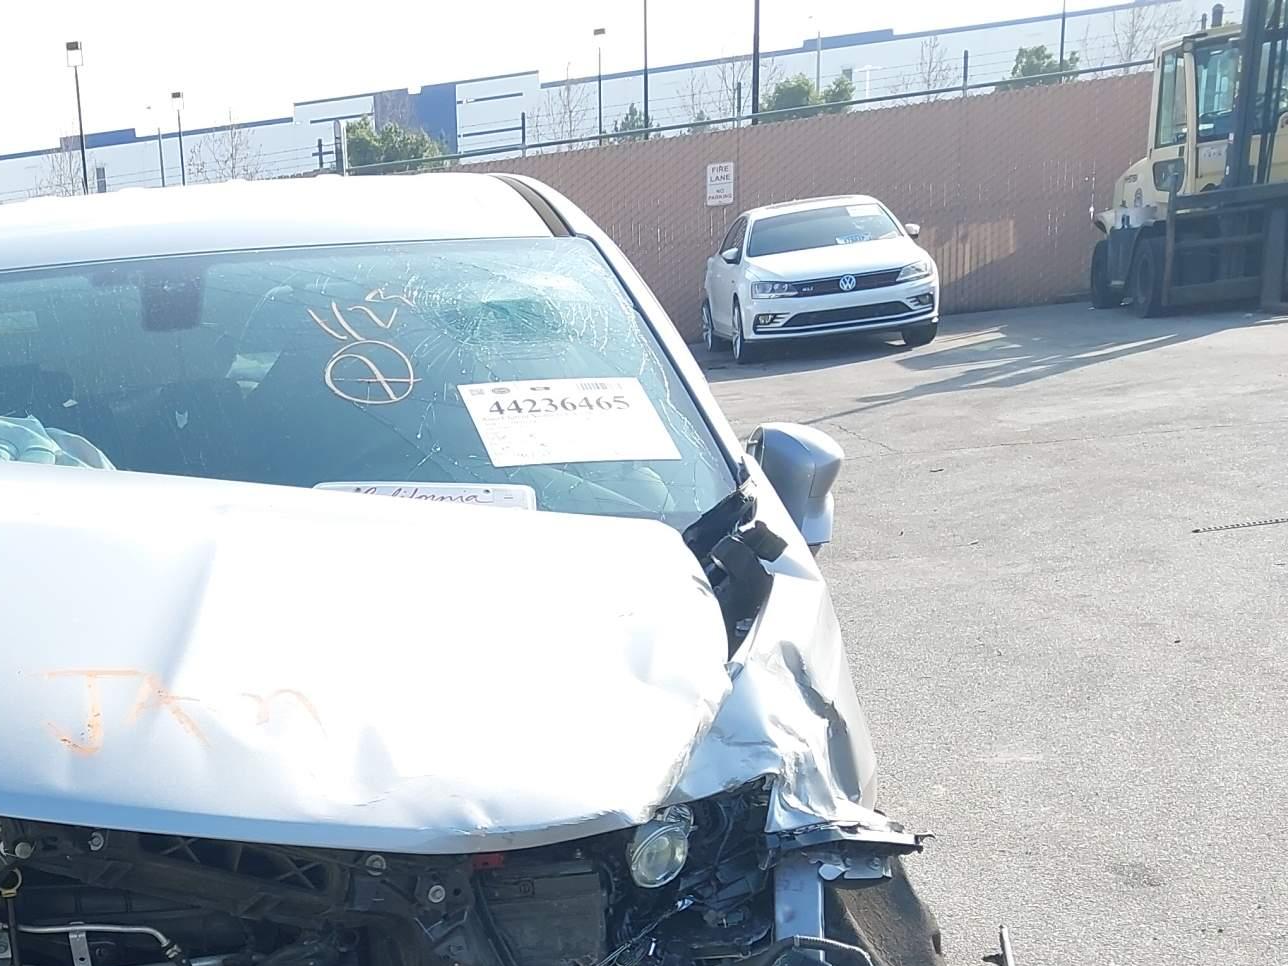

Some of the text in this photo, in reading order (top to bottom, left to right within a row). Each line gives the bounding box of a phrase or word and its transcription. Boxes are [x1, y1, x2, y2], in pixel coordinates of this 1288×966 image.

[711, 165, 729, 173] FIRE
[709, 174, 729, 183] LANE
[489, 396, 630, 415] 44236465
